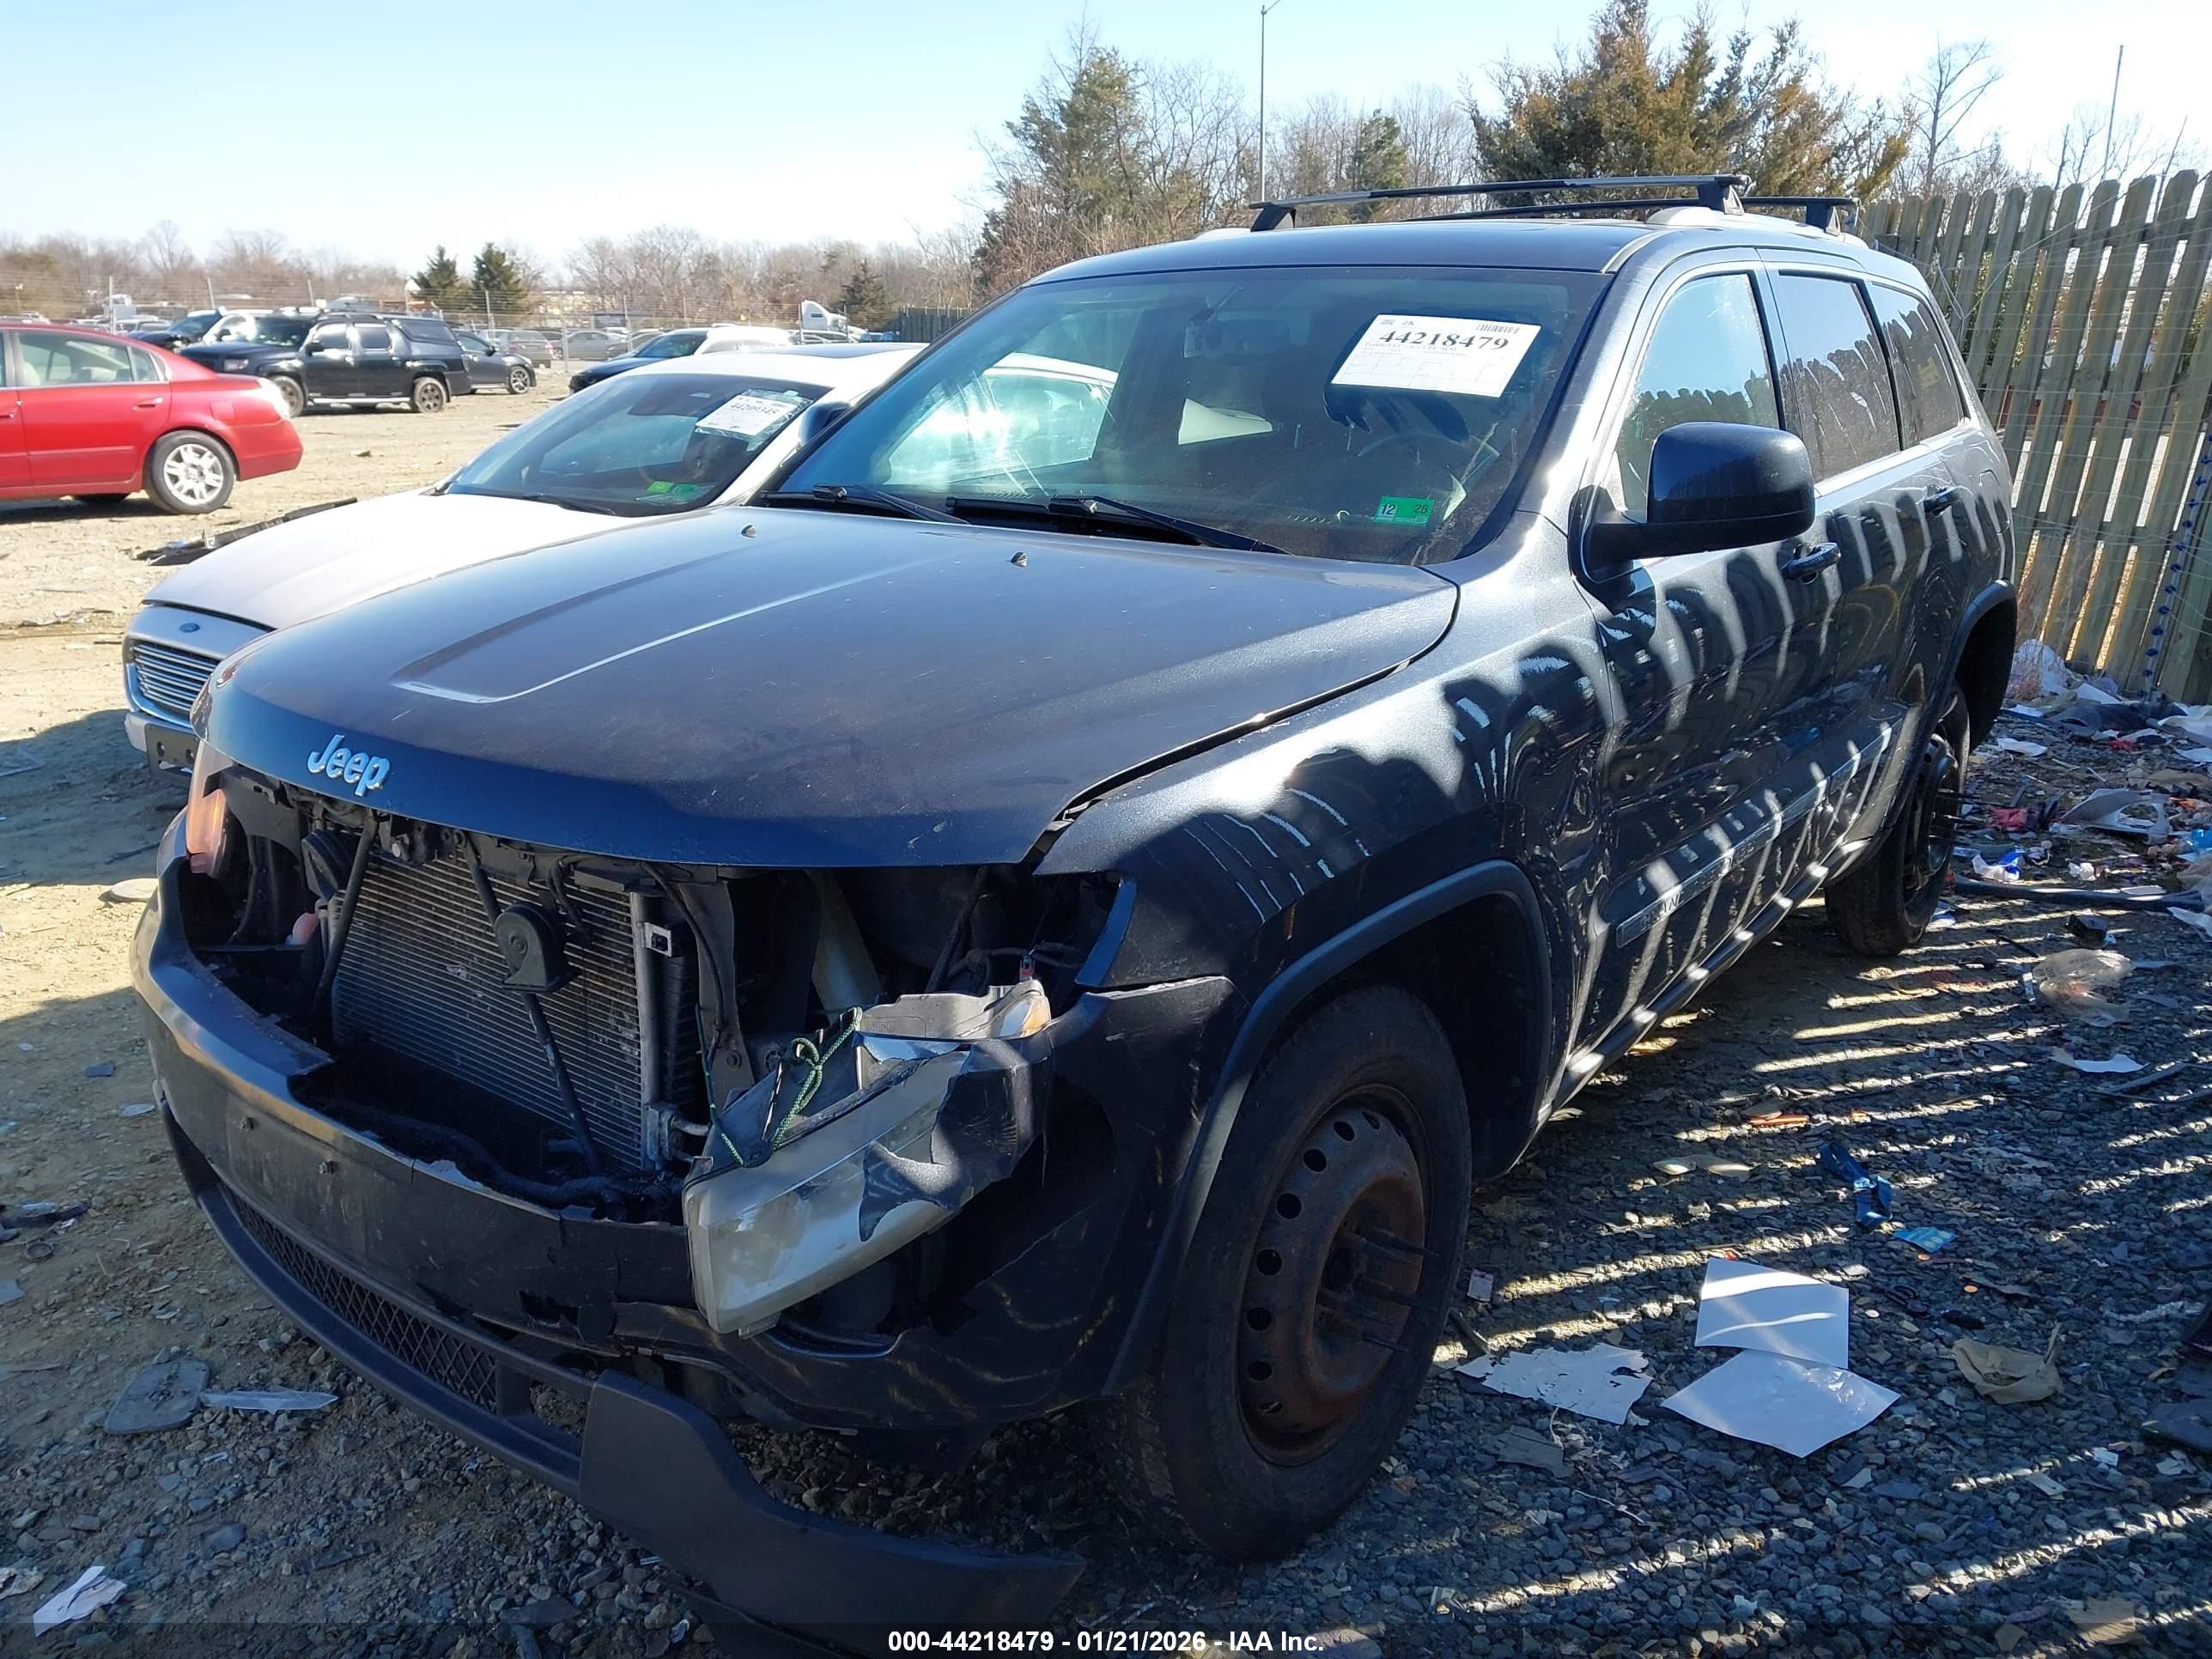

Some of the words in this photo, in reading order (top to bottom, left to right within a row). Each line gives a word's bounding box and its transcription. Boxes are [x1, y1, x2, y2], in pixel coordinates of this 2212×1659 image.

[1379, 330, 1510, 350] 44218479
[1381, 503, 1396, 515] 12
[1413, 504, 1429, 514] 26
[307, 734, 391, 797] Jeep
